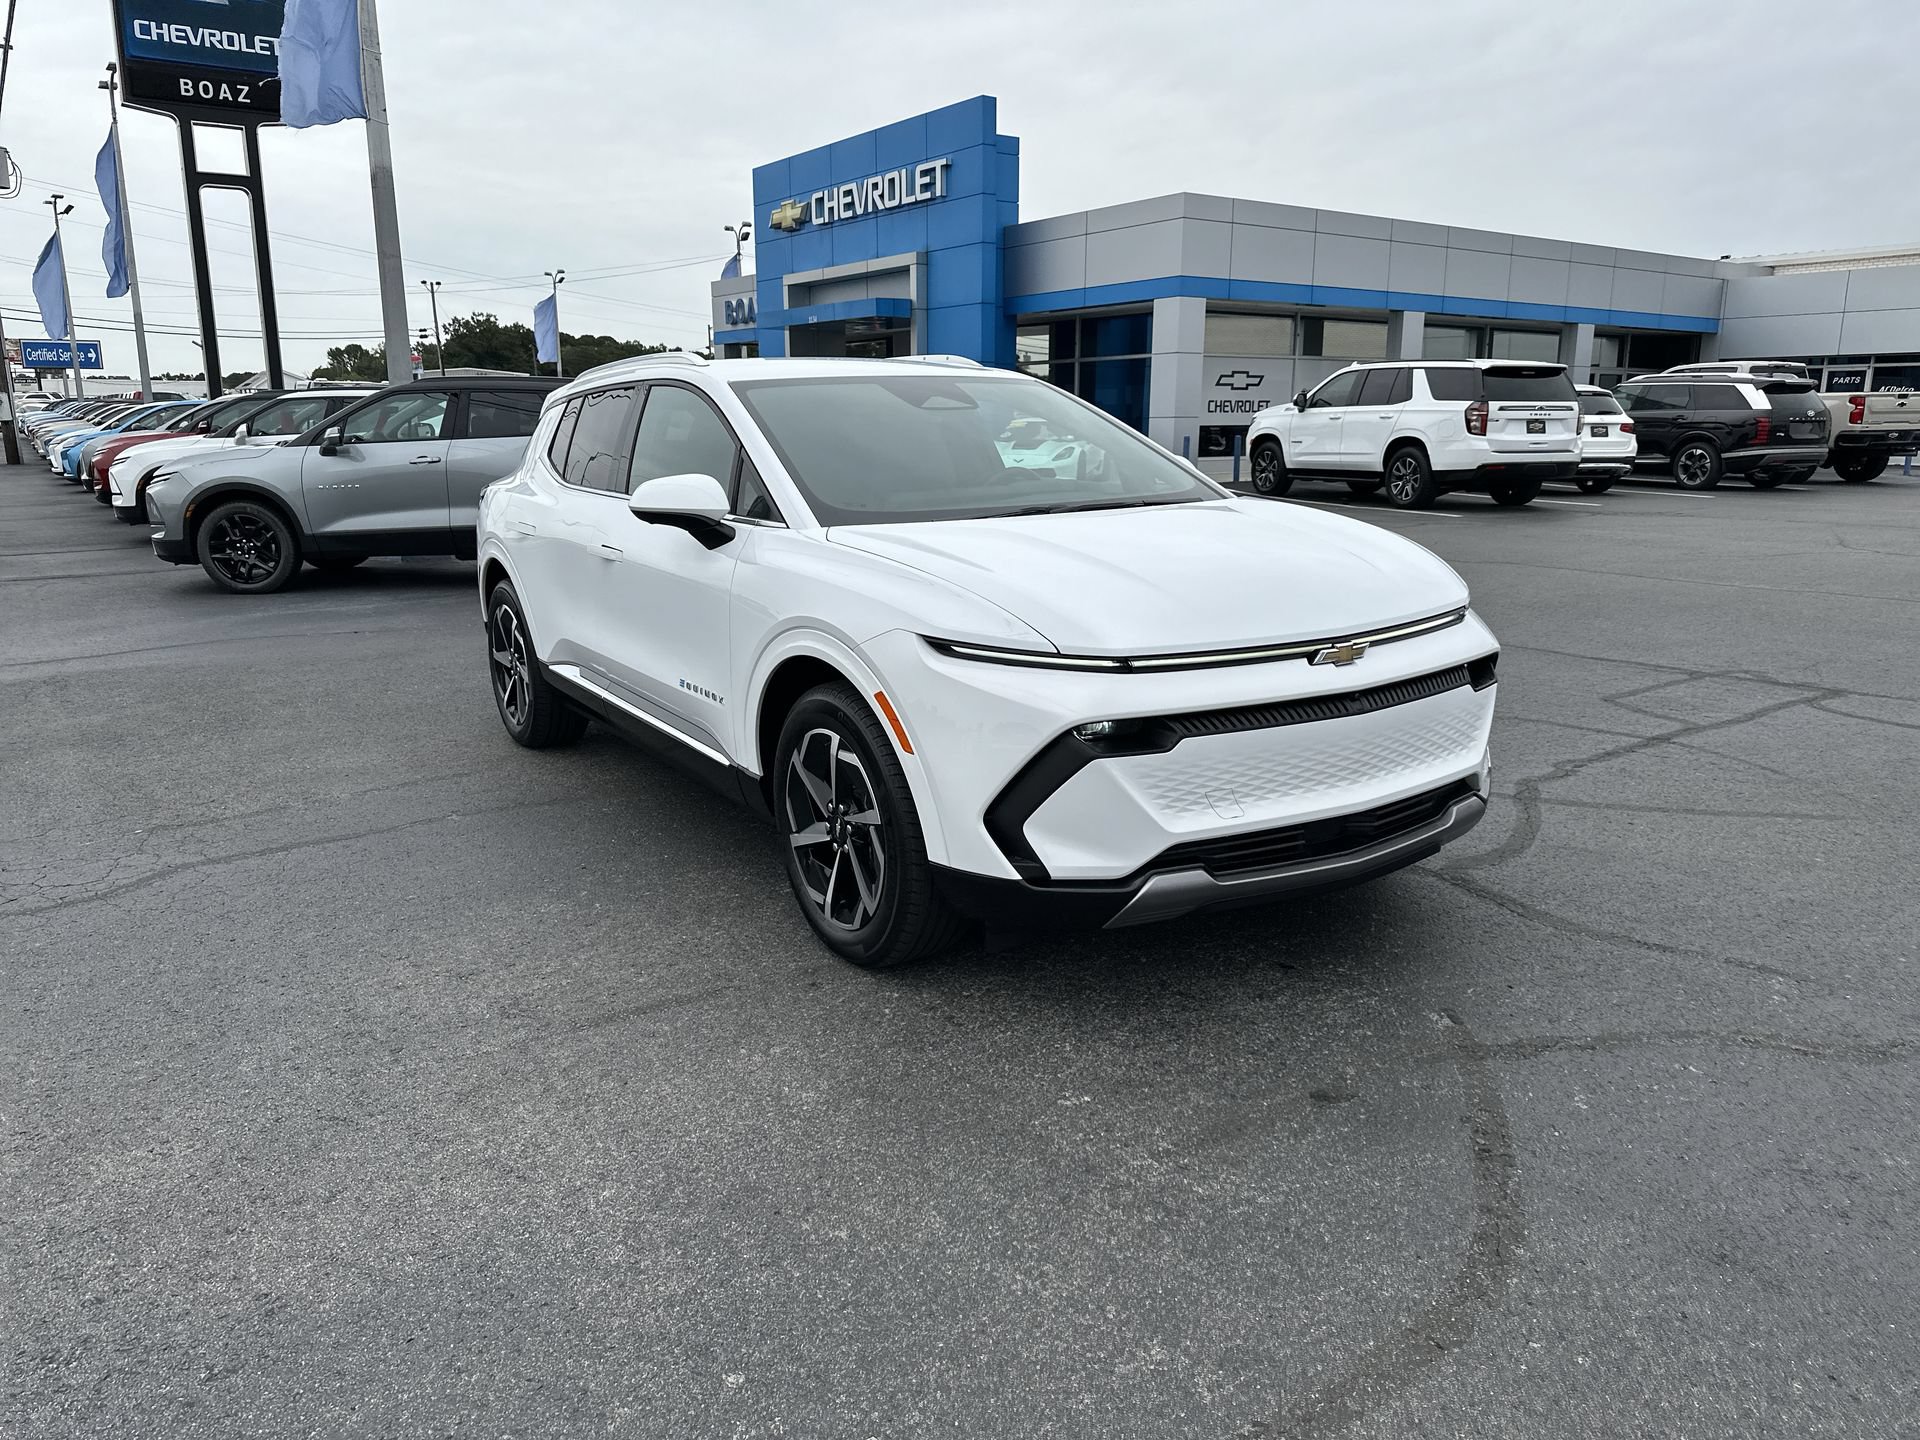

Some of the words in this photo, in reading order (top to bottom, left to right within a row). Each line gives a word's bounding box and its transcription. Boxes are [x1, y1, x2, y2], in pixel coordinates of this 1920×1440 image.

[133, 19, 280, 56] CHEVROLET
[179, 78, 251, 103] BOAZ
[811, 157, 948, 226] CHEVROLET
[26, 348, 57, 361] Certified
[59, 348, 85, 361] Serce
[1832, 376, 1861, 385] PARTS
[1207, 400, 1270, 413] CHEVROLET
